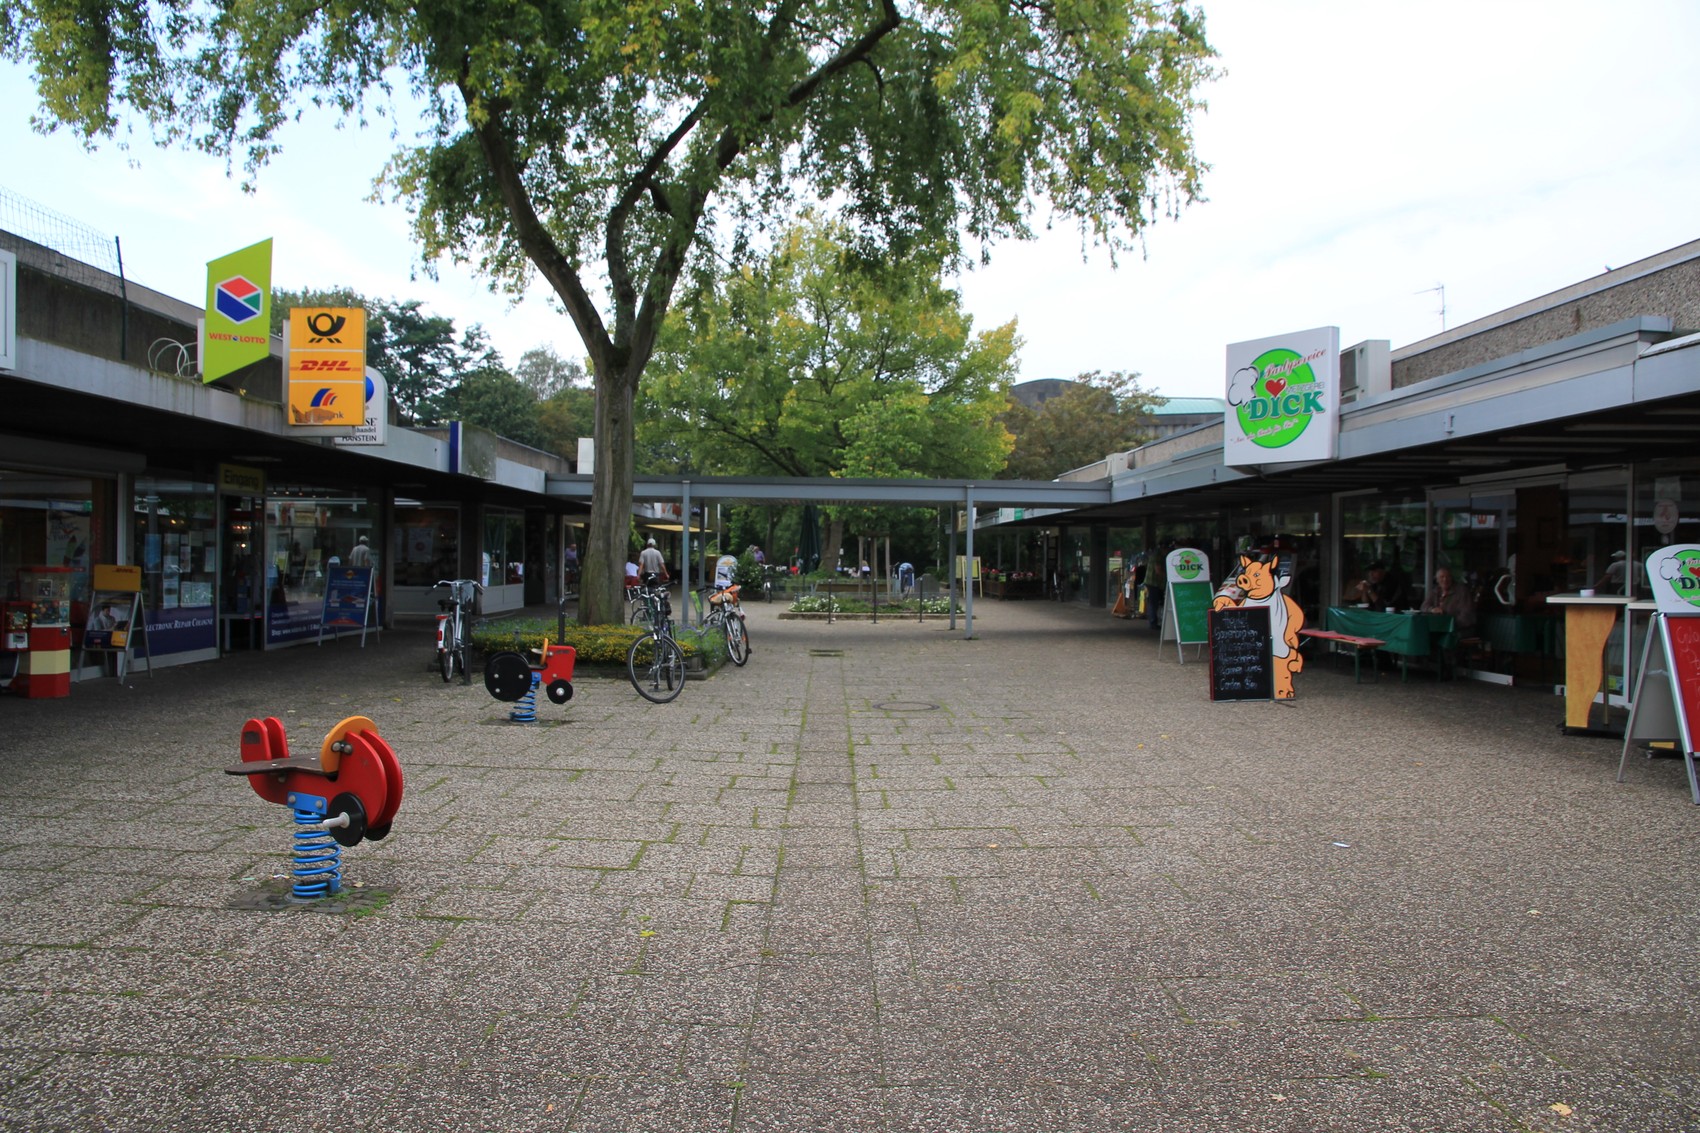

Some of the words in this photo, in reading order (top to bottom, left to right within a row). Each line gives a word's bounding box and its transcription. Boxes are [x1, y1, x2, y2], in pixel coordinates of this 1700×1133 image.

[209, 333, 232, 341] WEST
[239, 335, 266, 344] LOTTO
[300, 360, 351, 371] DHL
[1249, 390, 1325, 421] DICK
[224, 469, 259, 490] Eingang
[1179, 563, 1204, 571] DICK
[145, 622, 173, 632] LECTRONIC
